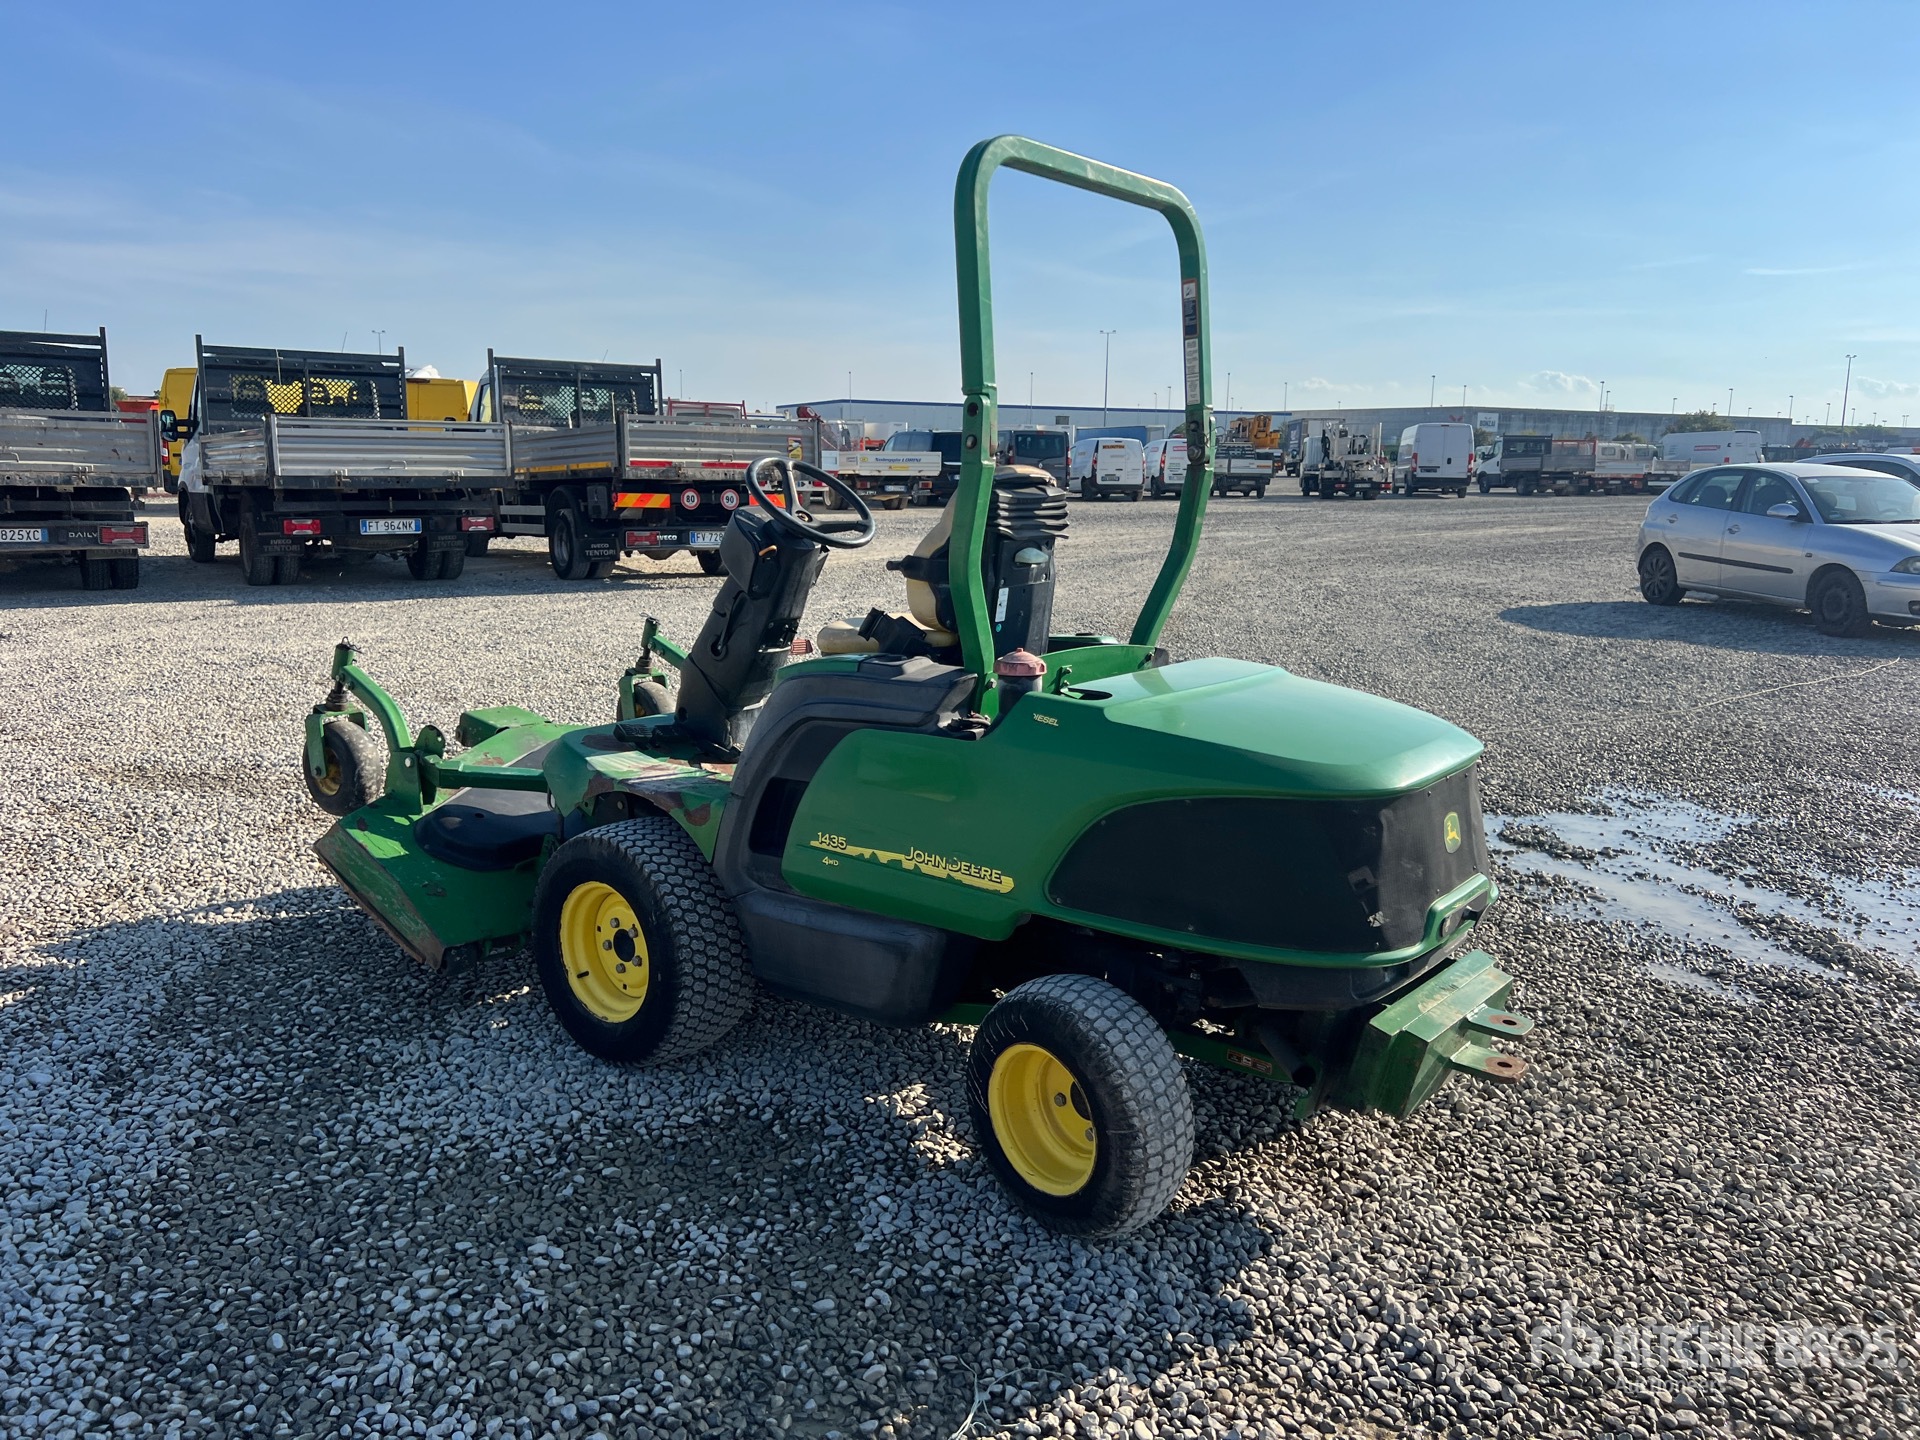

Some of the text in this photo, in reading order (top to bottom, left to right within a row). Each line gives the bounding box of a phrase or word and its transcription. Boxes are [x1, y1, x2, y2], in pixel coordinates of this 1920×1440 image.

[685, 494, 695, 503] 80
[725, 495, 735, 504] 90
[368, 519, 414, 532] FT 964NK
[0, 529, 40, 541] 825XC
[696, 532, 707, 542] FV
[263, 544, 300, 552] TENTORI
[817, 831, 848, 850] 1435
[822, 856, 839, 867] 4WD
[905, 846, 1002, 883] JOHN DEERE
